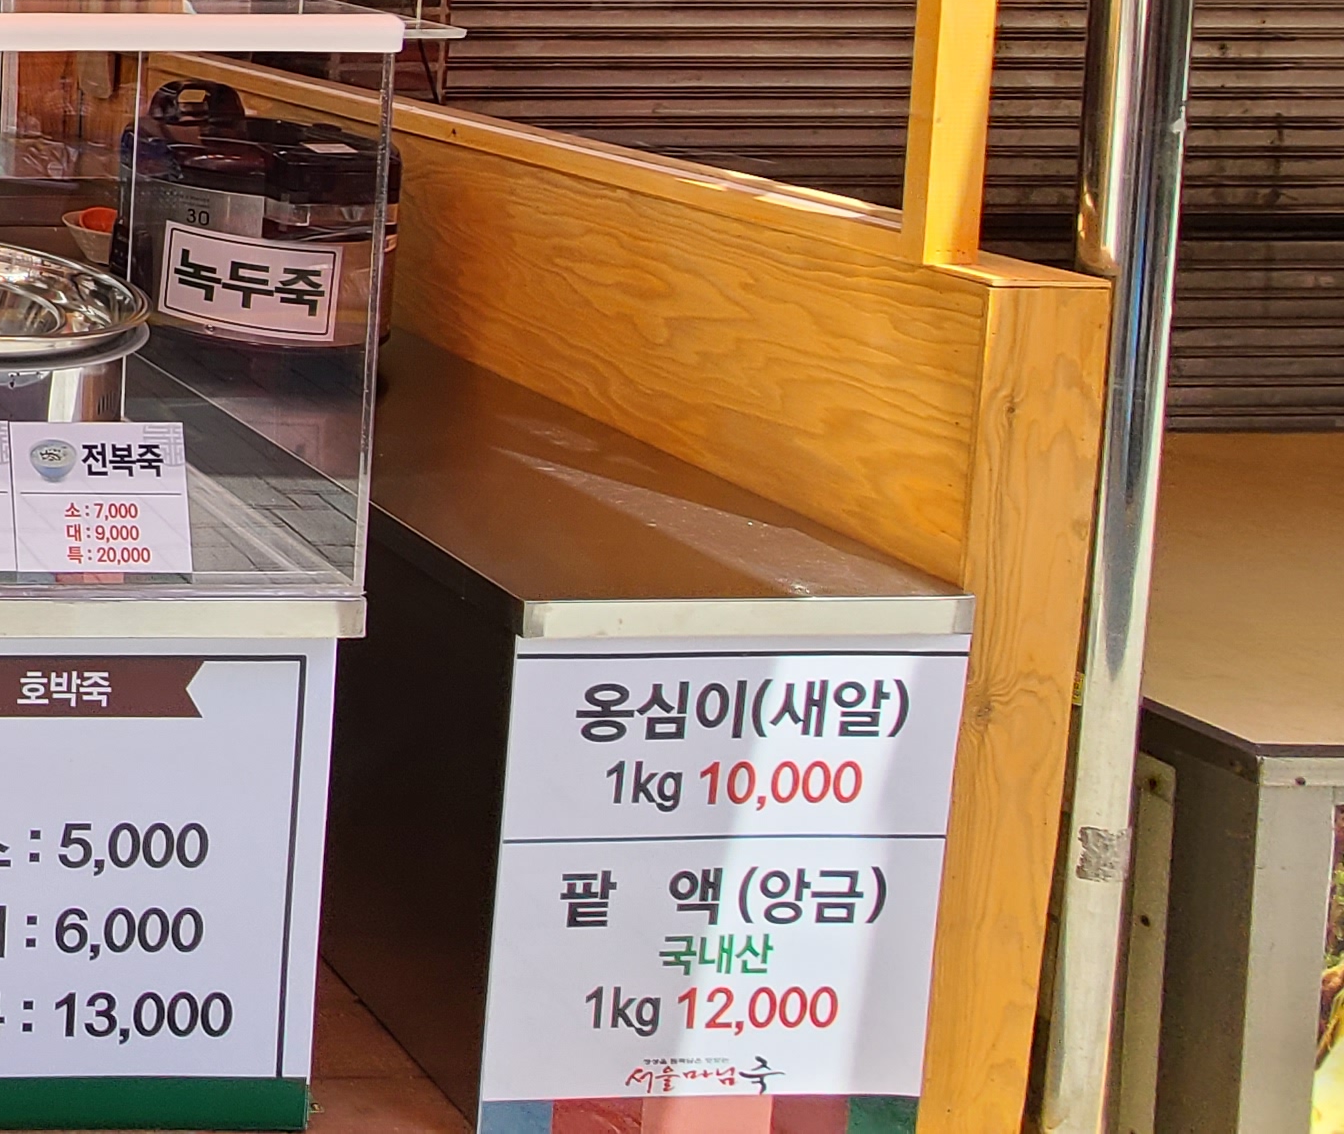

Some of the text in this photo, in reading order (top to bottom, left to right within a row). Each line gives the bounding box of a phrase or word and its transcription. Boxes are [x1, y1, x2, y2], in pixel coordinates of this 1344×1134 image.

[186, 208, 210, 226] 30
[173, 248, 326, 317] 녹두죽
[81, 442, 163, 477] 전복죽
[64, 502, 139, 521] 소 7,000
[65, 524, 140, 544] 대 9,000
[67, 546, 151, 566] 특 20,000
[16, 670, 113, 708] 호박죽
[575, 678, 911, 742] 옹심이(새알)
[605, 759, 863, 812] 1kg 10,000
[57, 822, 210, 876] 5,000
[560, 869, 617, 928] 팥
[54, 906, 204, 961] 6,000
[659, 933, 774, 976] 국내산
[54, 991, 233, 1046] 13,000
[585, 986, 839, 1037] 1kg 12,000
